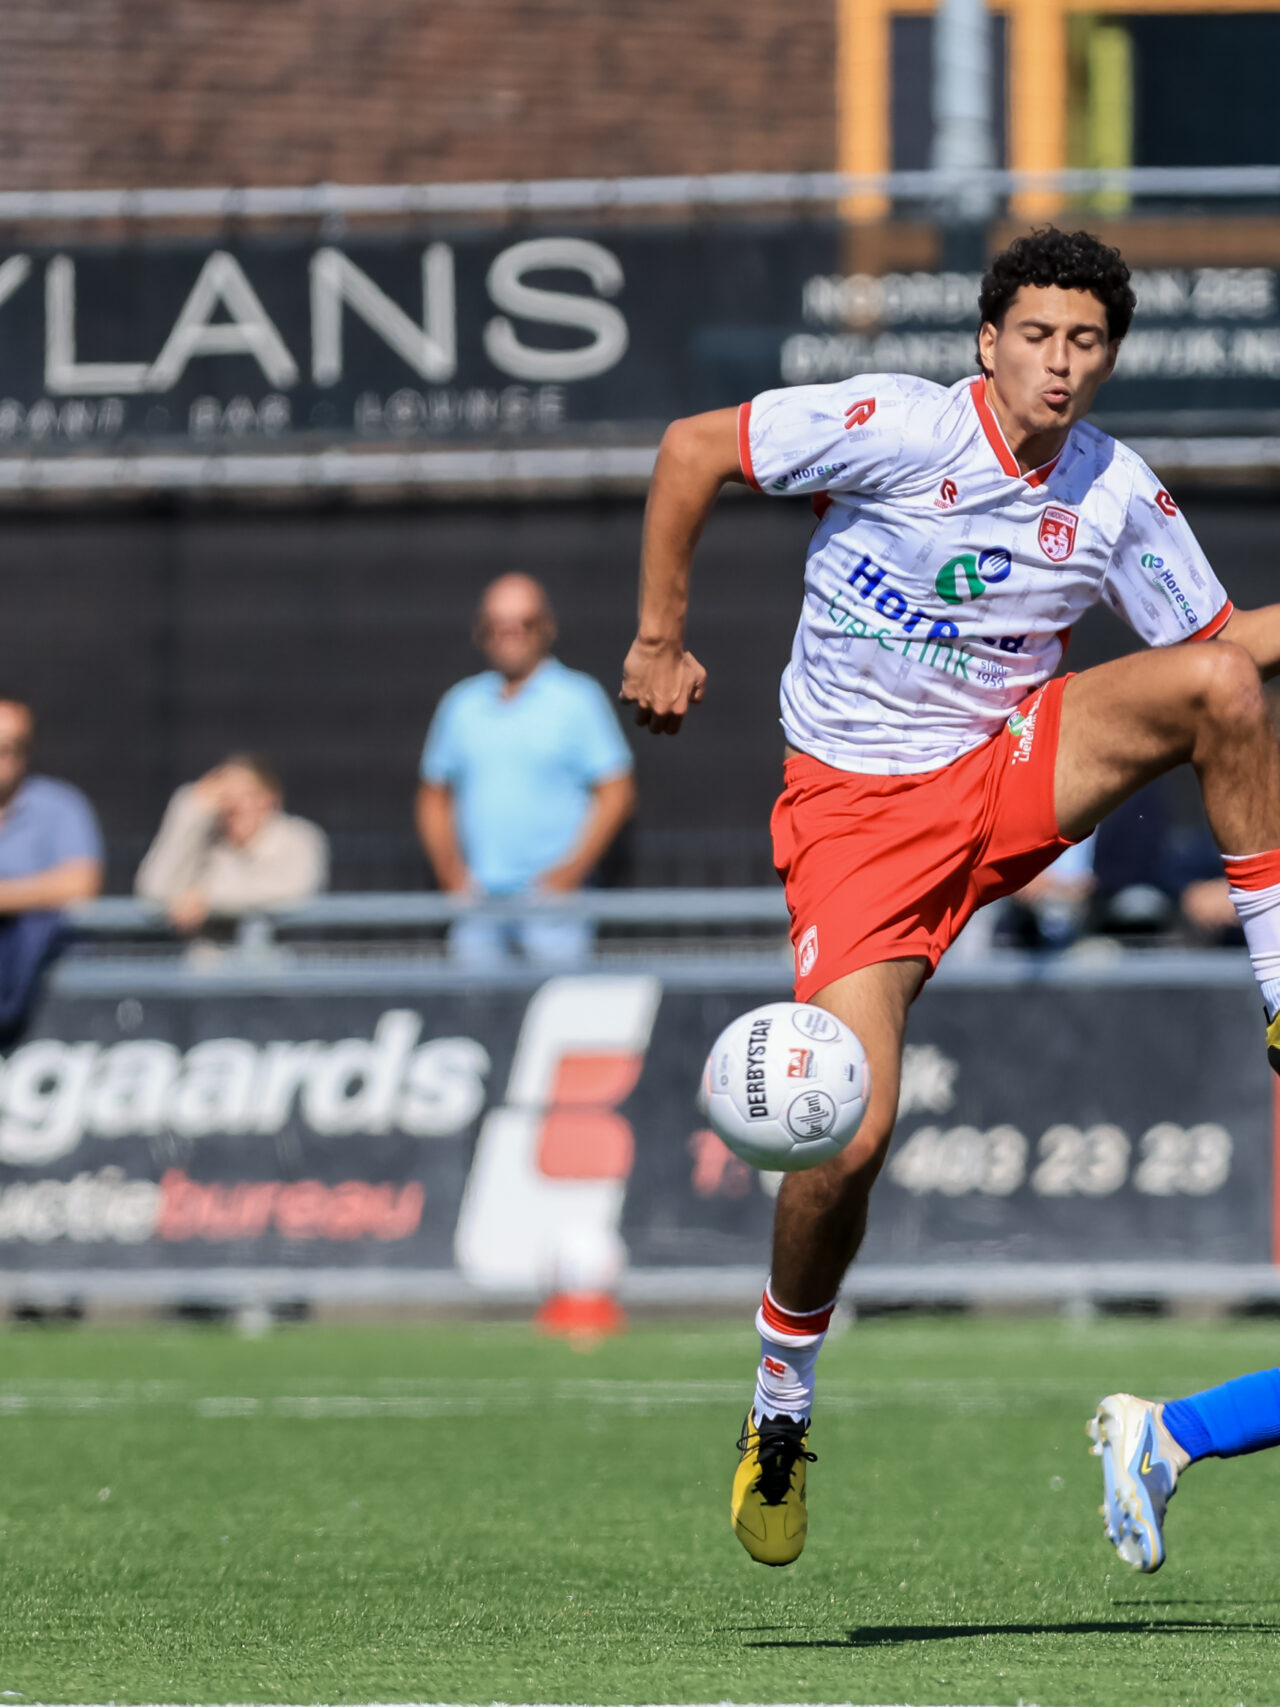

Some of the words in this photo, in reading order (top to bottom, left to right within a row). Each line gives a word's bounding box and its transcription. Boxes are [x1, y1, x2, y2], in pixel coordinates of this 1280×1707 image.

[354, 384, 568, 437] LOUNGE
[1160, 568, 1198, 625] Horesca
[0, 1008, 490, 1165] gaards
[746, 1018, 773, 1118] DERBYSTAR
[888, 1124, 1028, 1197] 403
[1031, 1123, 1131, 1197] 23
[1133, 1121, 1233, 1197] 23
